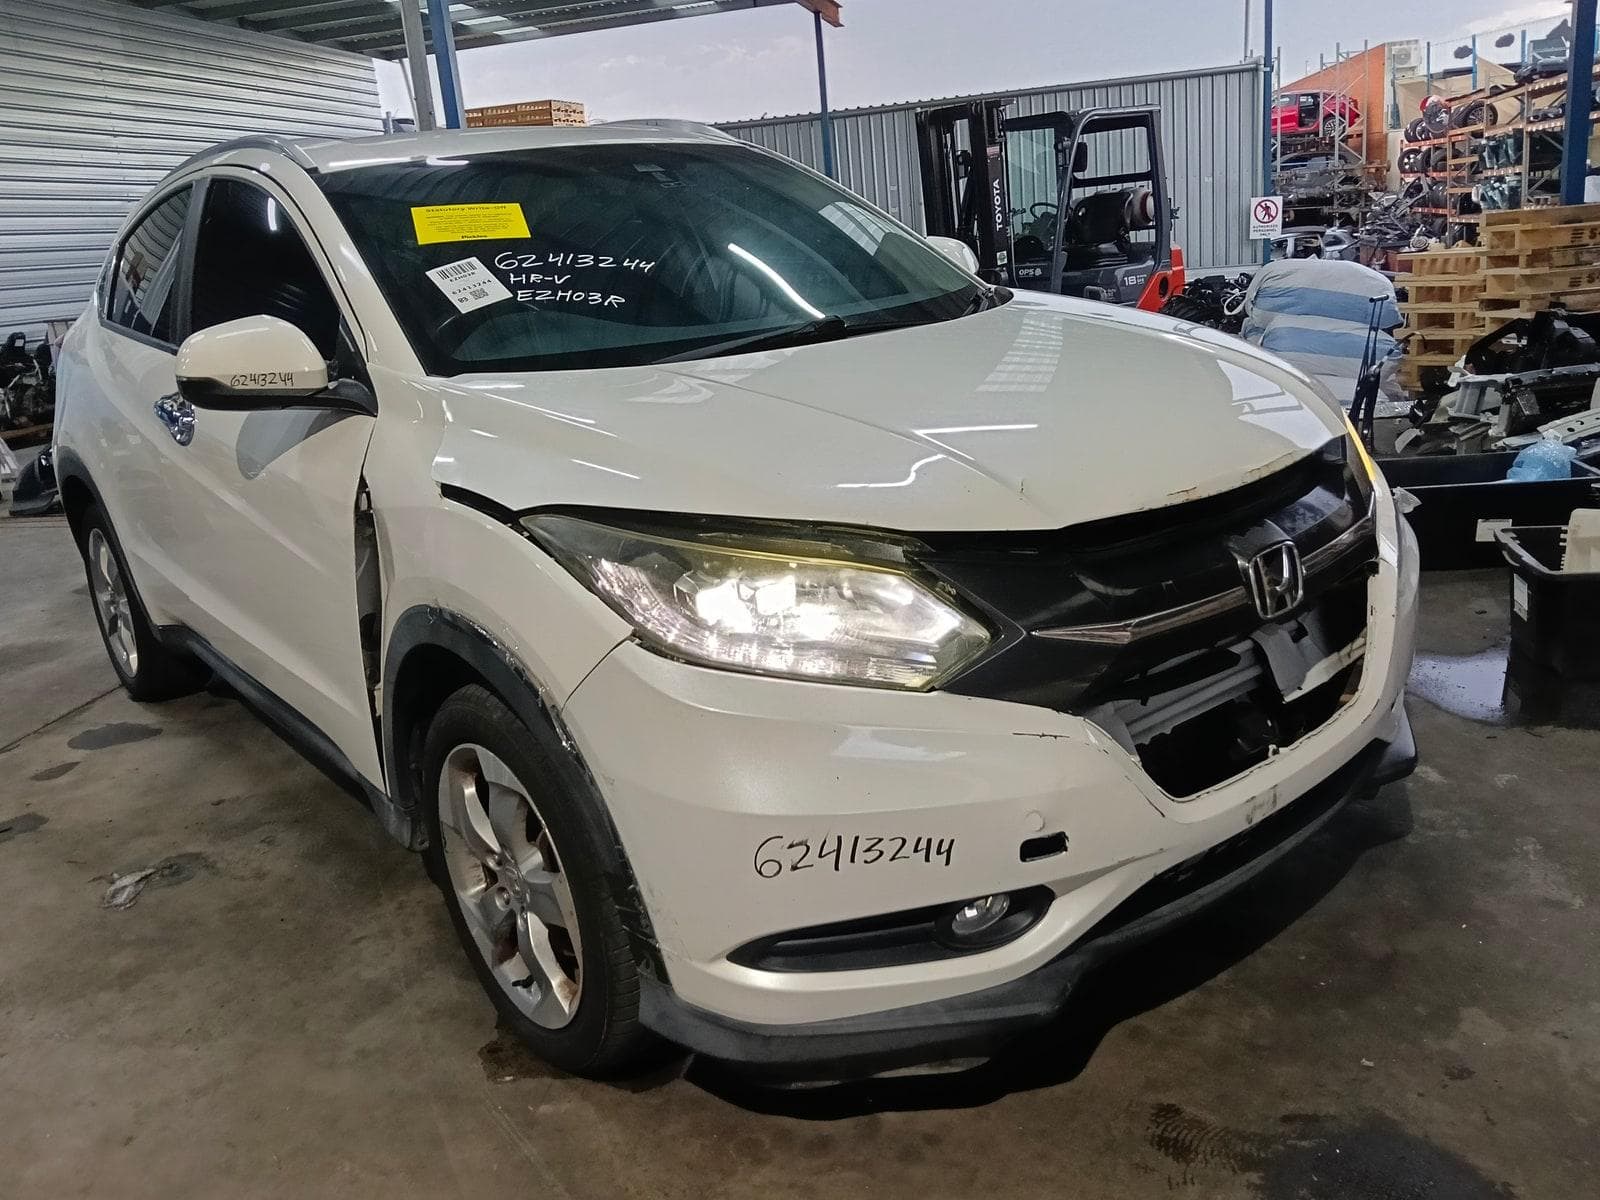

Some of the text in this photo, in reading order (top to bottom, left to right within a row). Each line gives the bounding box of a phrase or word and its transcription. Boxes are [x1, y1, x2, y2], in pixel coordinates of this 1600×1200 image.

[993, 178, 1003, 232] TOYOTA
[494, 251, 656, 273] 62413244
[509, 273, 572, 285] HR-V
[1018, 268, 1034, 276] OPS
[230, 371, 294, 387] 62413244
[754, 833, 955, 878] 62413244
